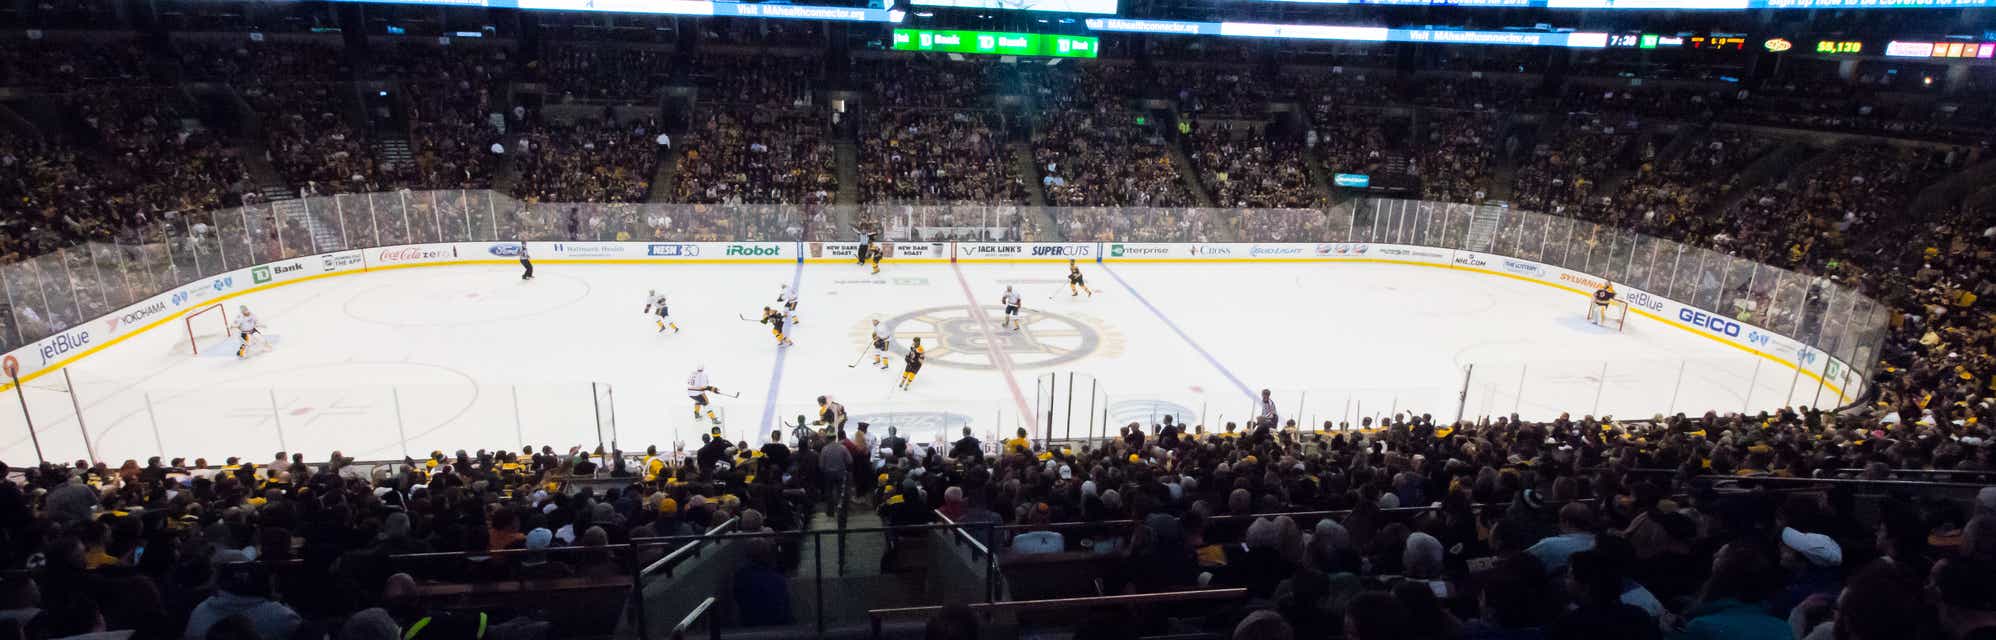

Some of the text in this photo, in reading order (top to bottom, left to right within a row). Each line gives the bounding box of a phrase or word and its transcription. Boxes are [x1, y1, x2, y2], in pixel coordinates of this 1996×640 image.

[727, 246, 780, 256] iRobot
[1032, 246, 1089, 256] SUPERCUTS
[275, 263, 303, 275] Bank
[121, 302, 166, 327] YOKOHAMA
[1679, 308, 1740, 337] GEICO
[40, 331, 90, 365] jetBlue
